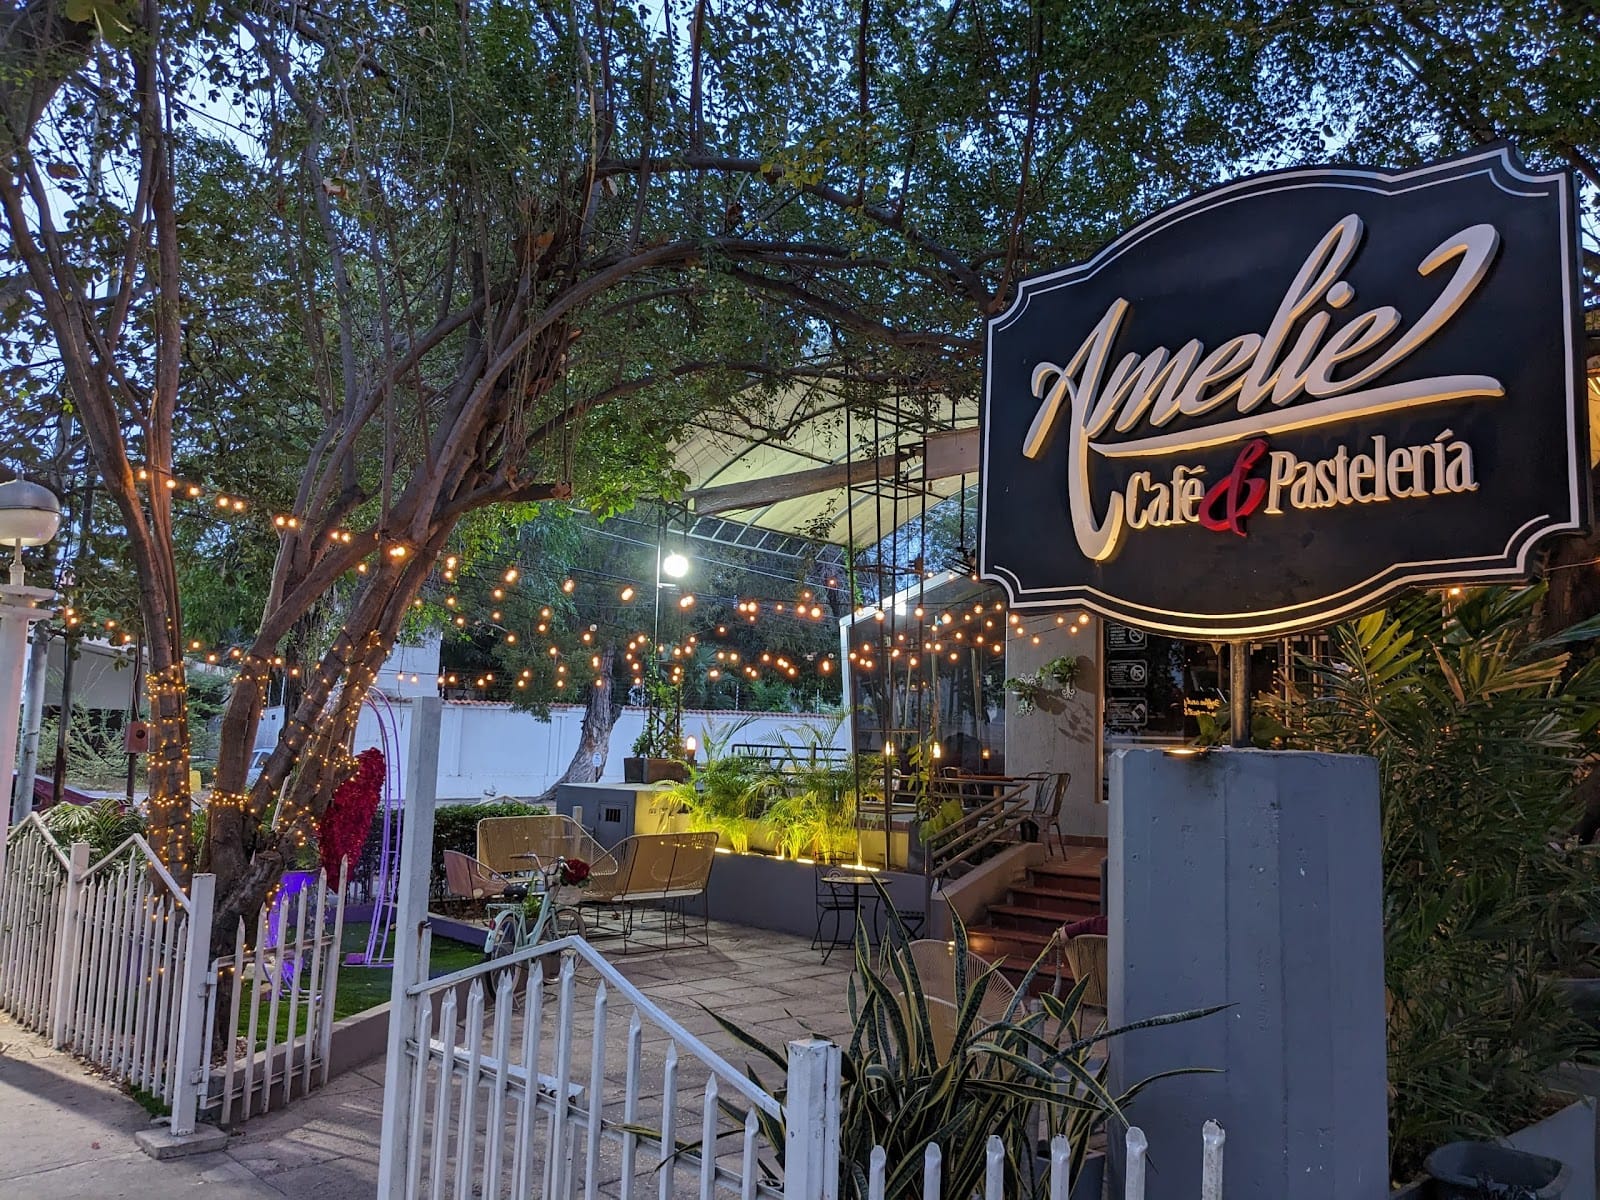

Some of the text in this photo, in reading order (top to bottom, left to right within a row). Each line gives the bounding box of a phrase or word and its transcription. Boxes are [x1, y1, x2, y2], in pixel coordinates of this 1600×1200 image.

[1023, 213, 1503, 560] Amelie
[1126, 428, 1480, 537] Café & Pastelería
